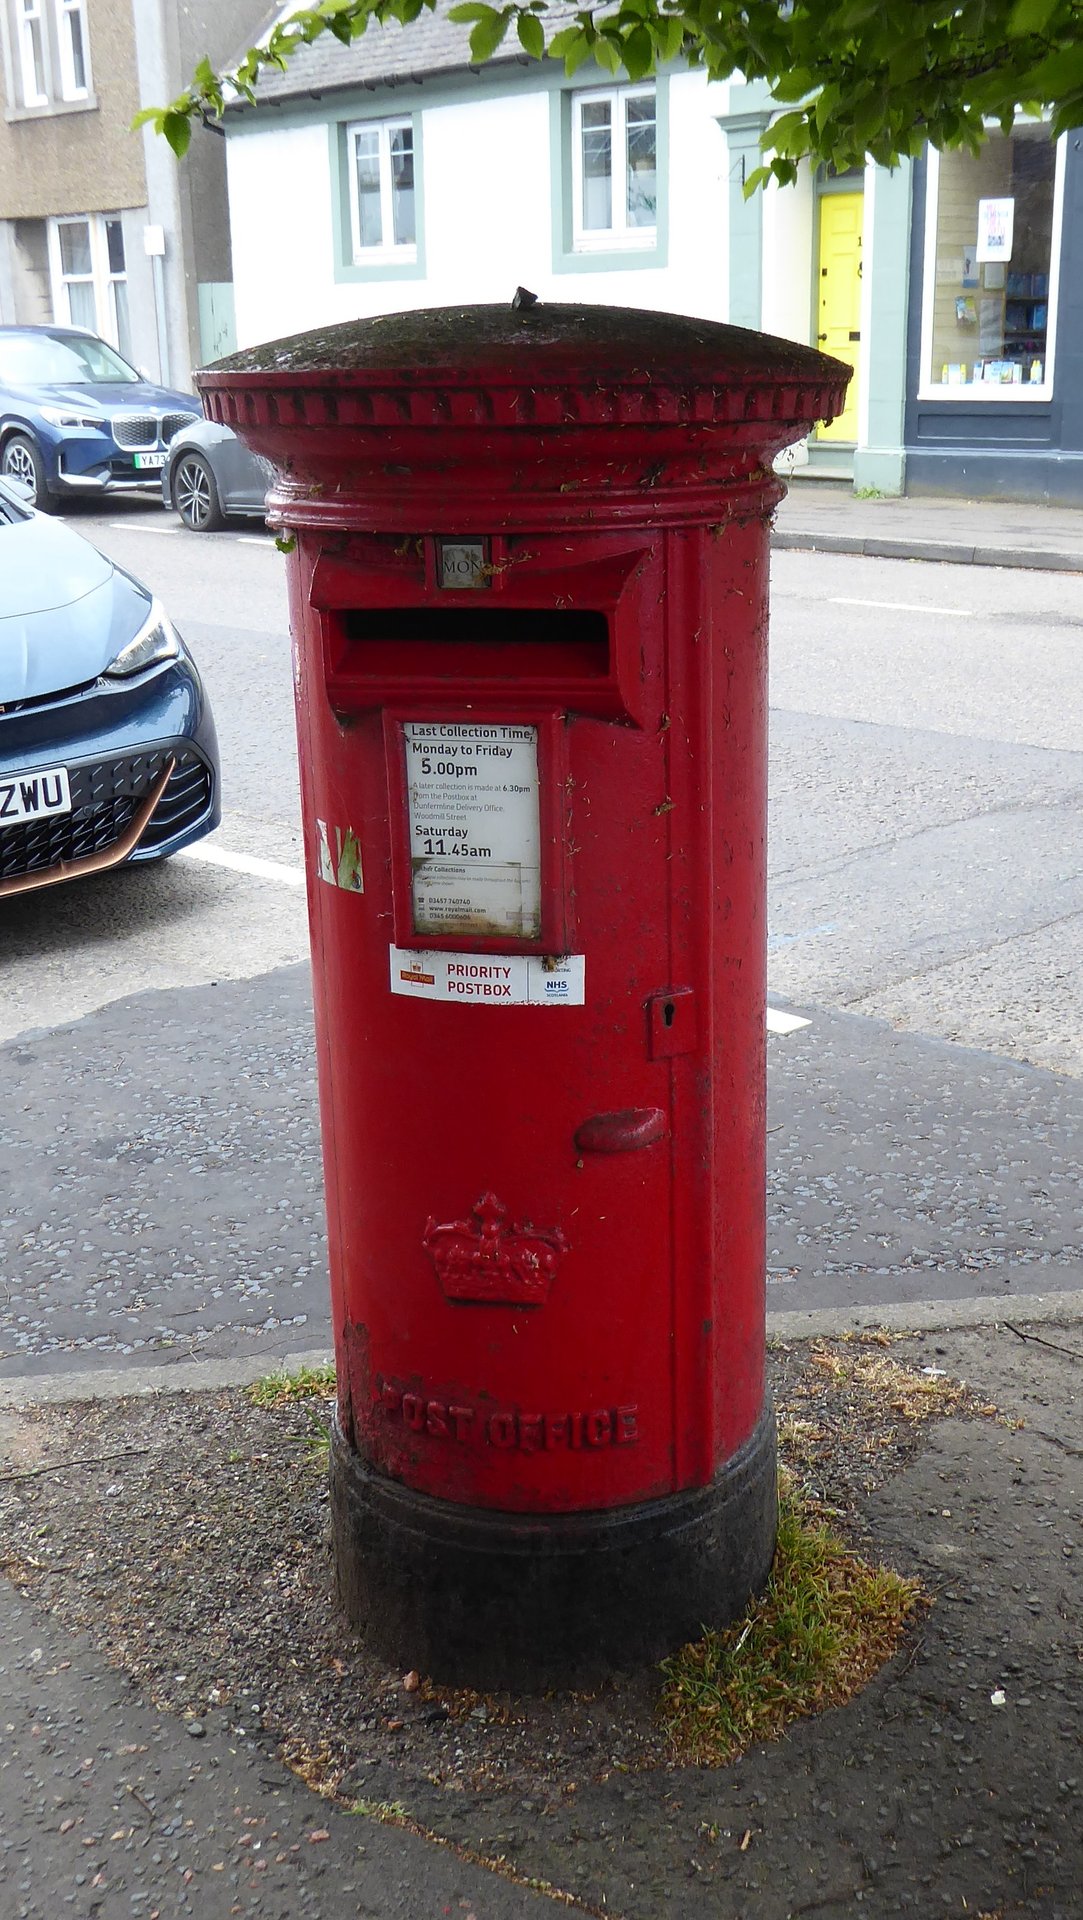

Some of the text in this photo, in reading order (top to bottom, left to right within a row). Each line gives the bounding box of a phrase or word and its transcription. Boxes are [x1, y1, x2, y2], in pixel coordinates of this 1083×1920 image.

[412, 725, 436, 736] Last
[440, 726, 497, 738] Collection
[412, 743, 512, 758] Monday to Friday
[422, 758, 478, 778] 5.00pm
[0, 775, 63, 818] ZWU
[503, 785, 530, 793] 6.30pm
[414, 802, 455, 810] Dunfermline
[456, 804, 482, 812] Delivery
[416, 825, 468, 839] Saturday
[424, 839, 492, 857] 11.45am
[448, 964, 512, 978] PRIORITY
[448, 981, 512, 996] POSTBOX
[487, 1404, 640, 1449] OFFICE
